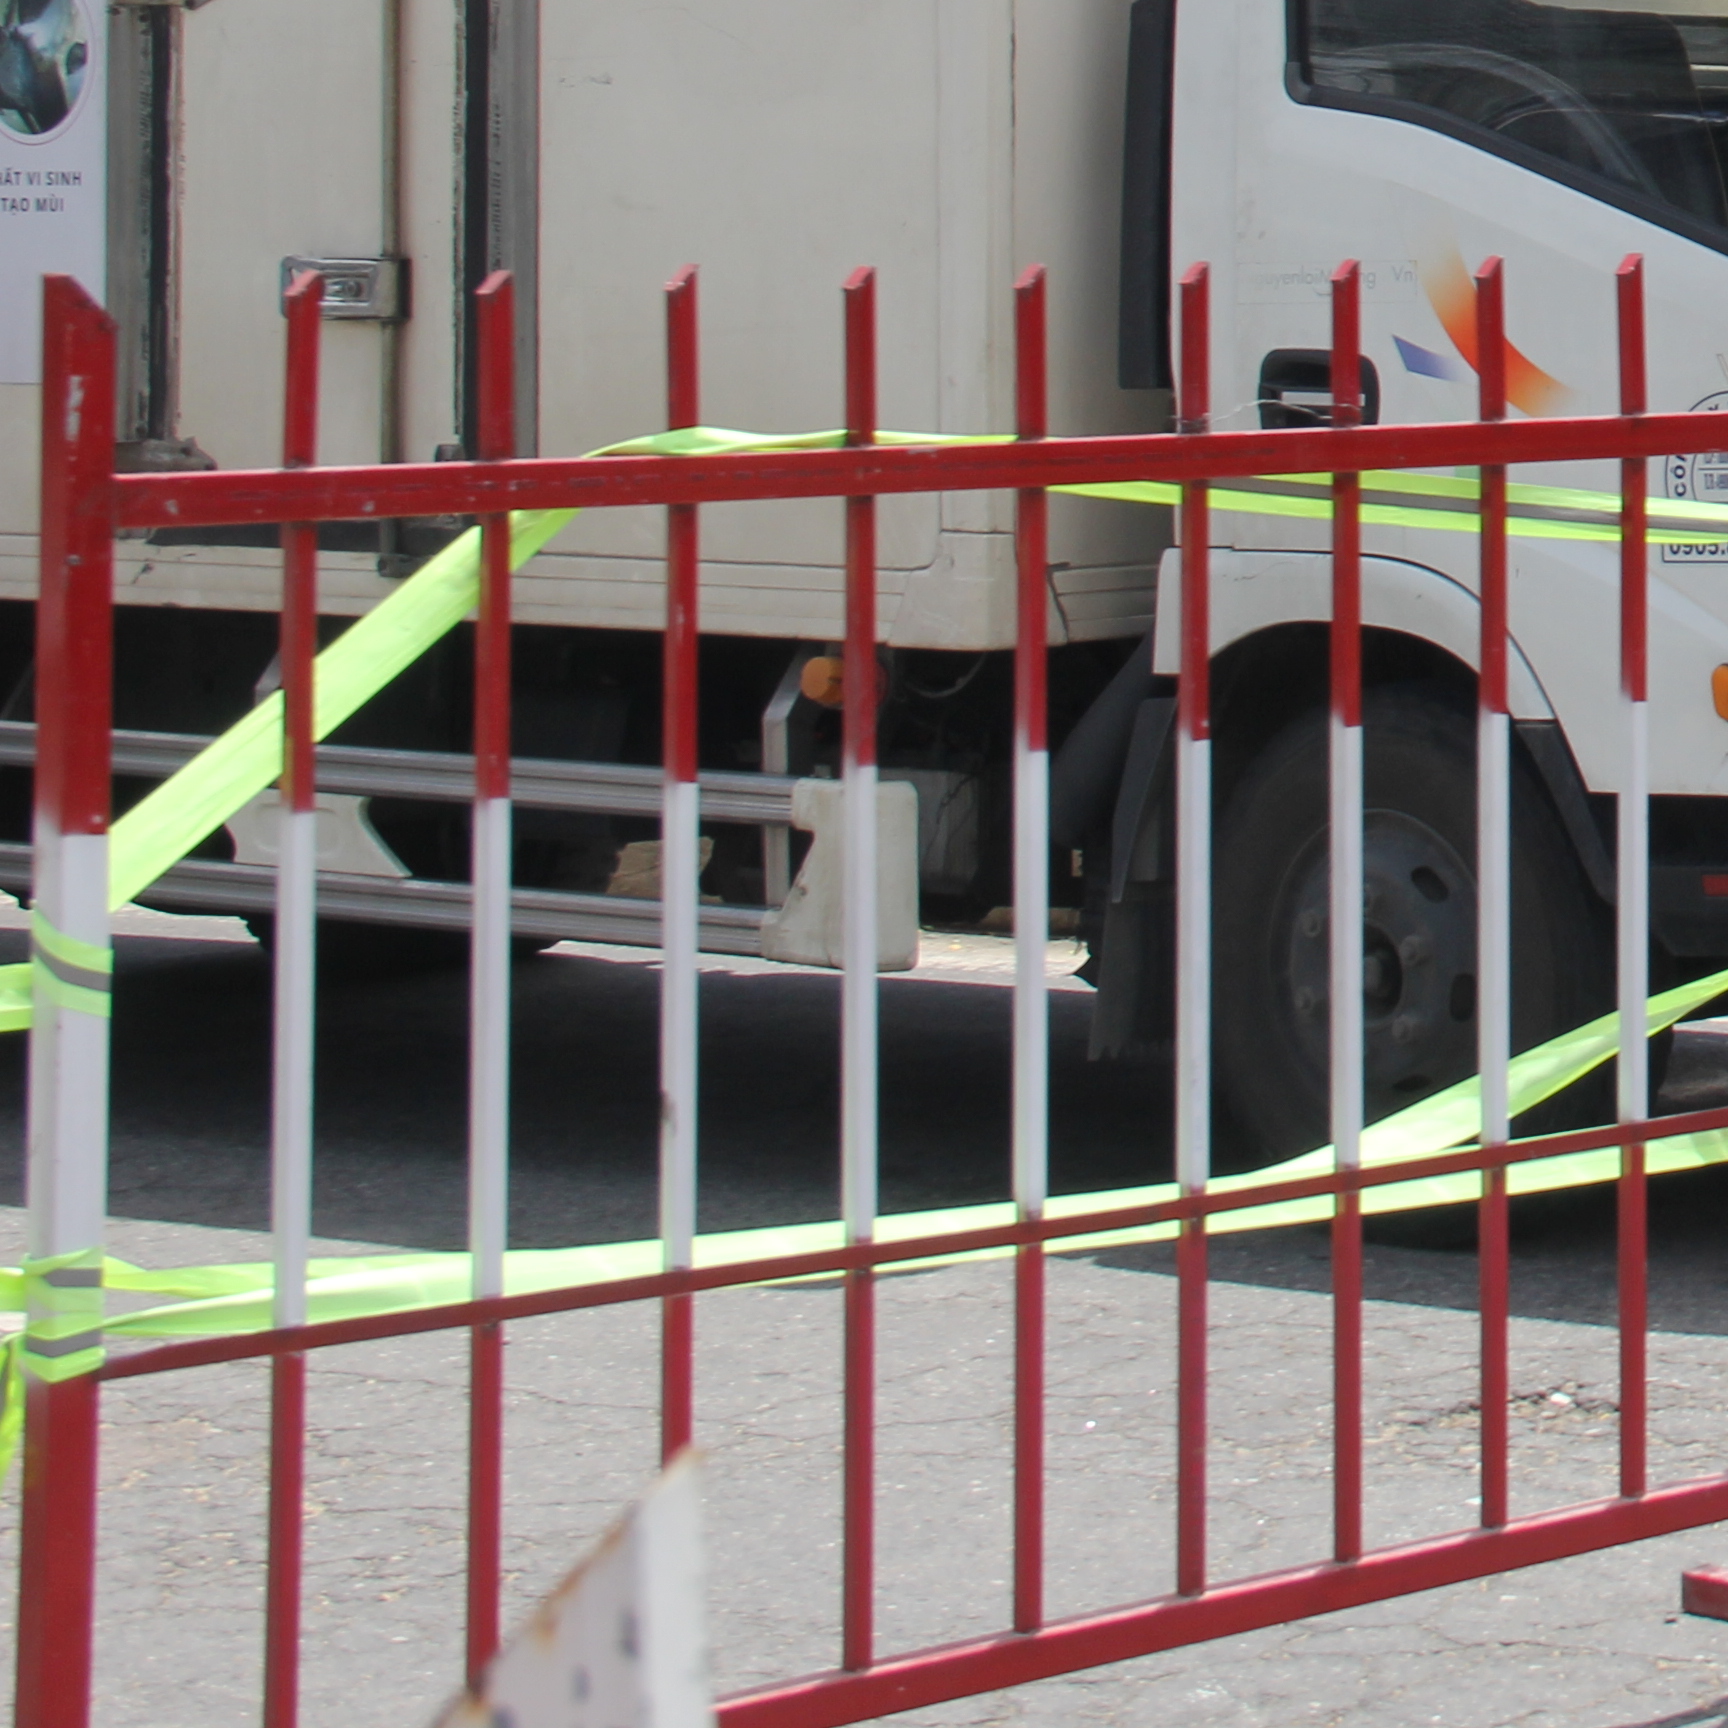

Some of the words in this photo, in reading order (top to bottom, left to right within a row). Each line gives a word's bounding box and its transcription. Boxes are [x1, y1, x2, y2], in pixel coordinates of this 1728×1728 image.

[0, 167, 21, 186] ẤT
[28, 172, 41, 186] VI
[46, 171, 82, 186] SINH
[1, 197, 31, 216] TẠO
